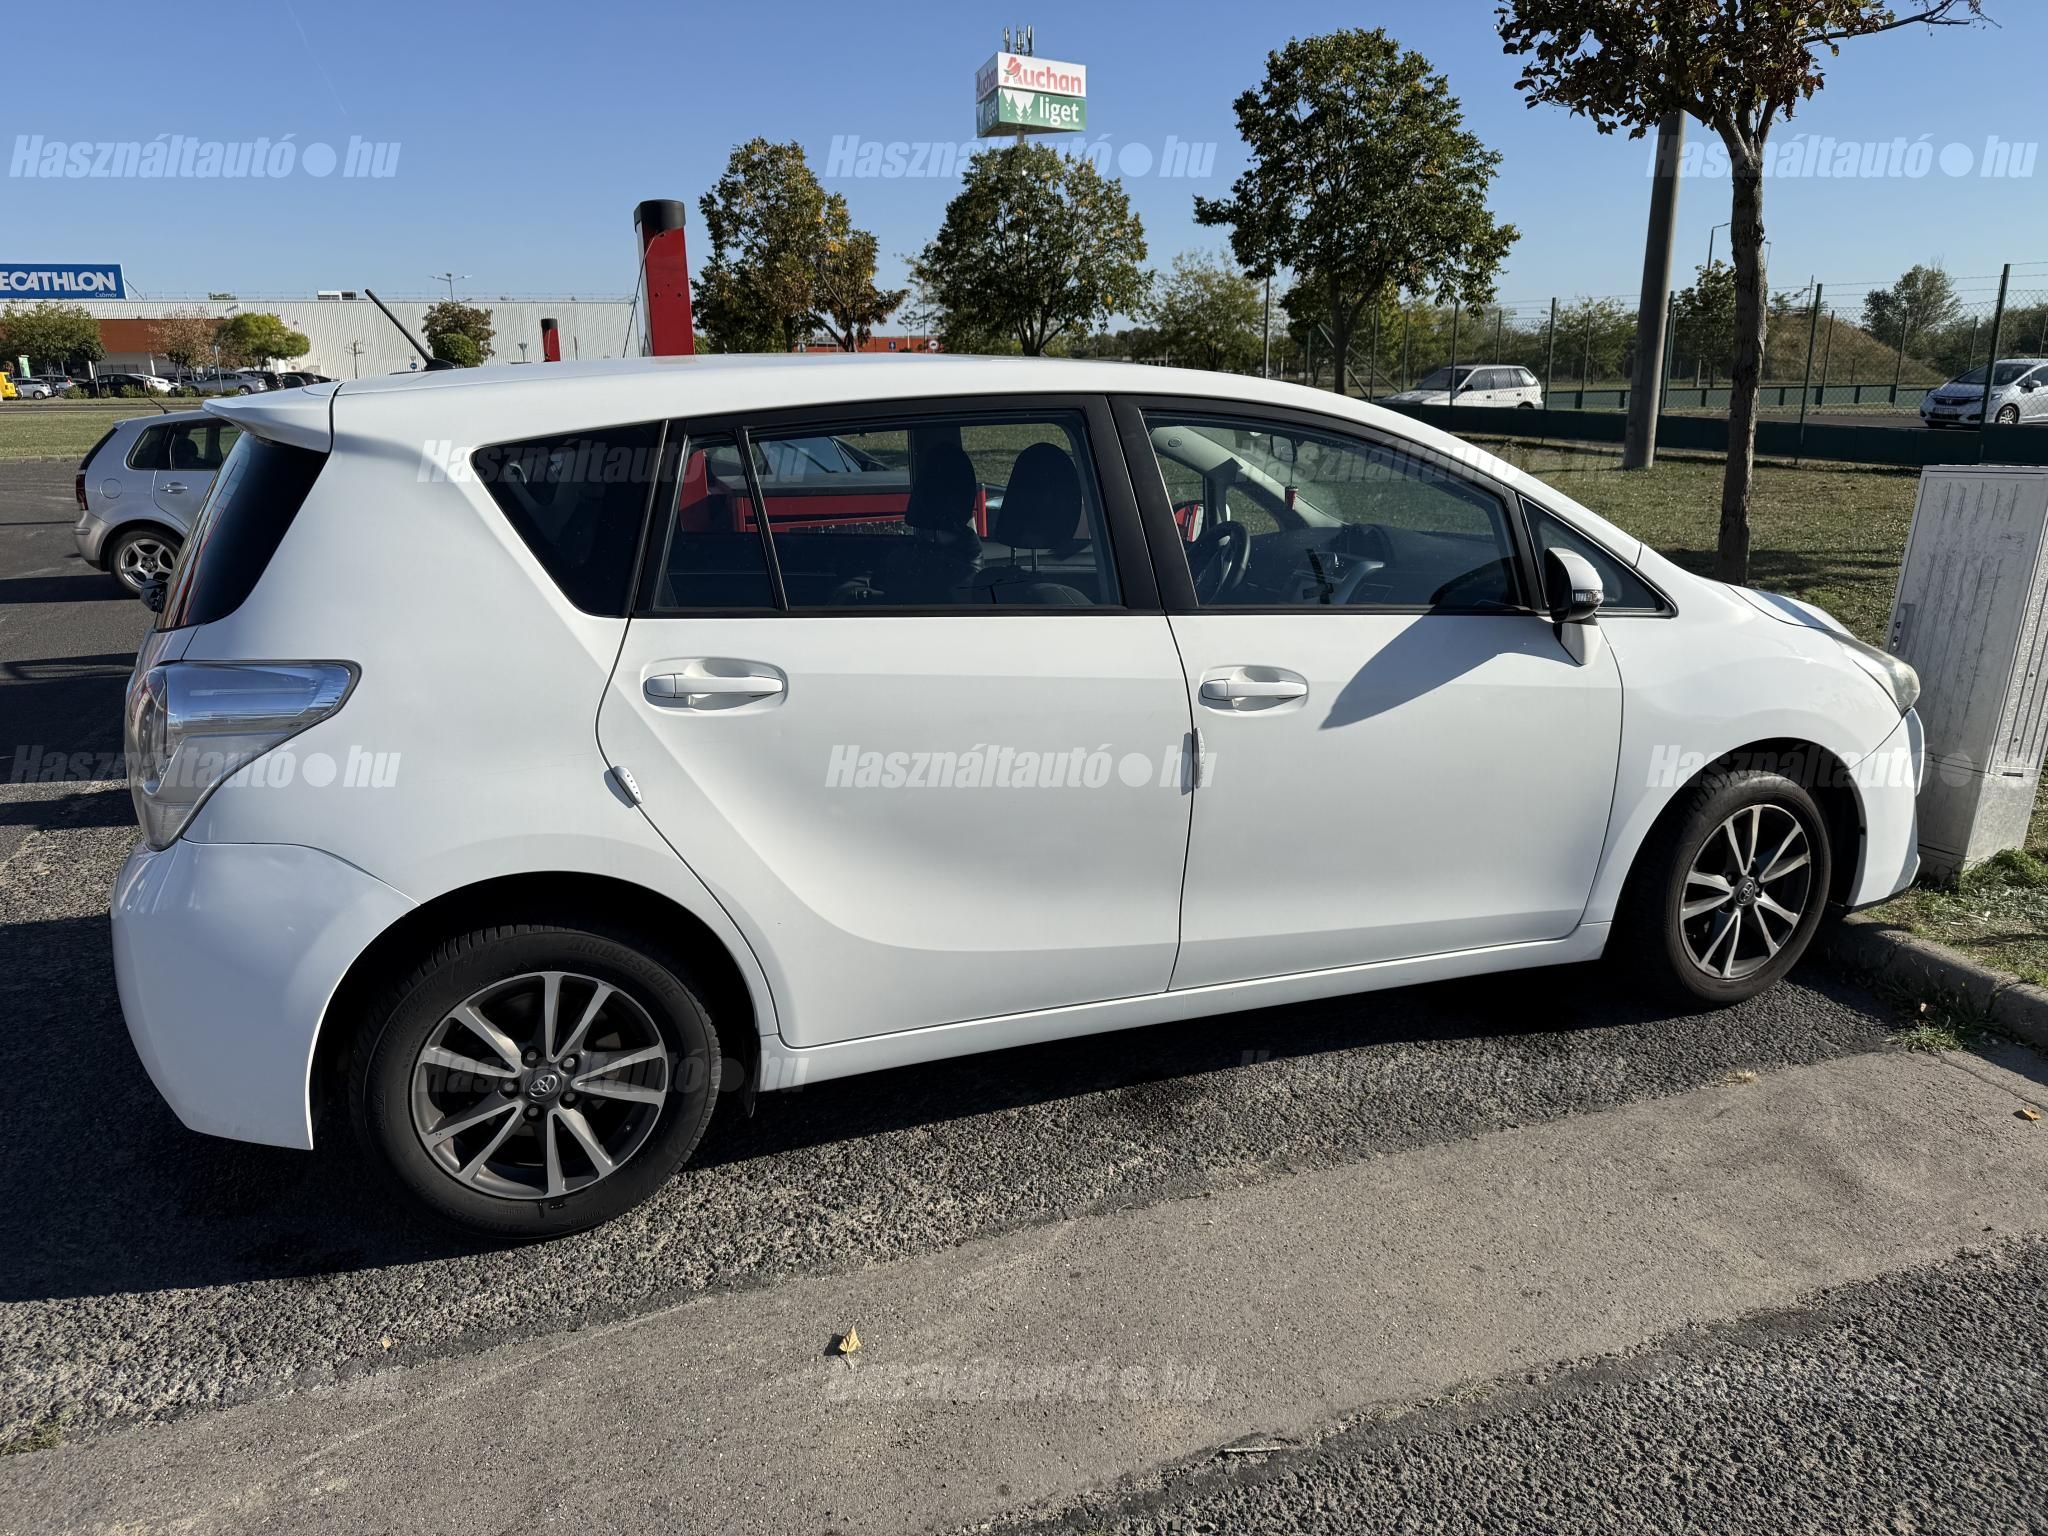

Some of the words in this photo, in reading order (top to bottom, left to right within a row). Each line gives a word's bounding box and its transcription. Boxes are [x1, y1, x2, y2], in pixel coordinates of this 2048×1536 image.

[1004, 56, 1083, 93] Auchan
[1040, 96, 1080, 126] liget
[0, 271, 116, 291] ECATHLON
